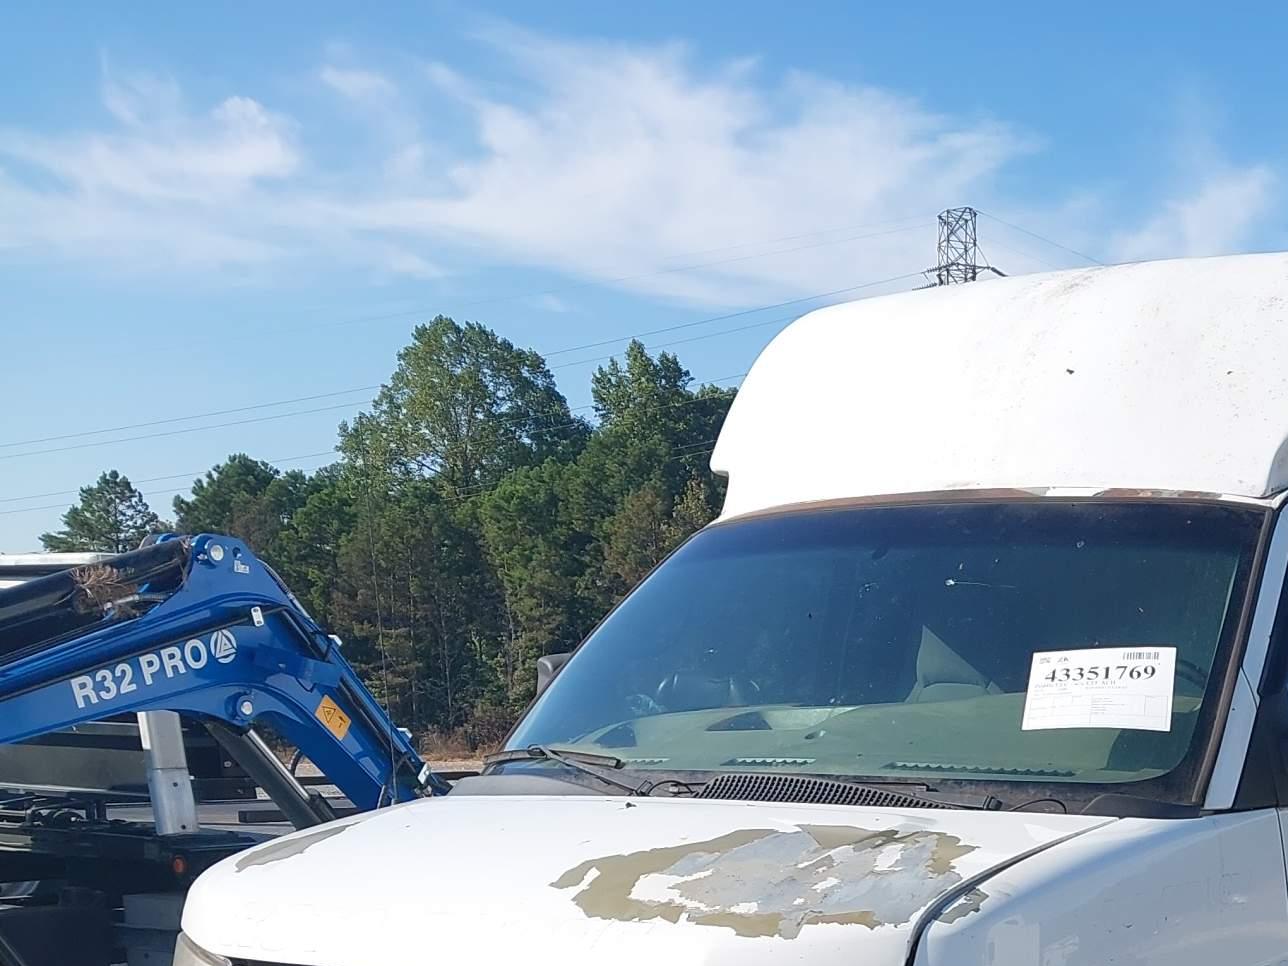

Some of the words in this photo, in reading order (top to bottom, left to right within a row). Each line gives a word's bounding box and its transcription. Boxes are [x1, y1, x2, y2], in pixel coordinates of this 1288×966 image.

[70, 663, 137, 709] R32
[139, 638, 208, 685] PRO
[1044, 665, 1156, 682] 43351769
